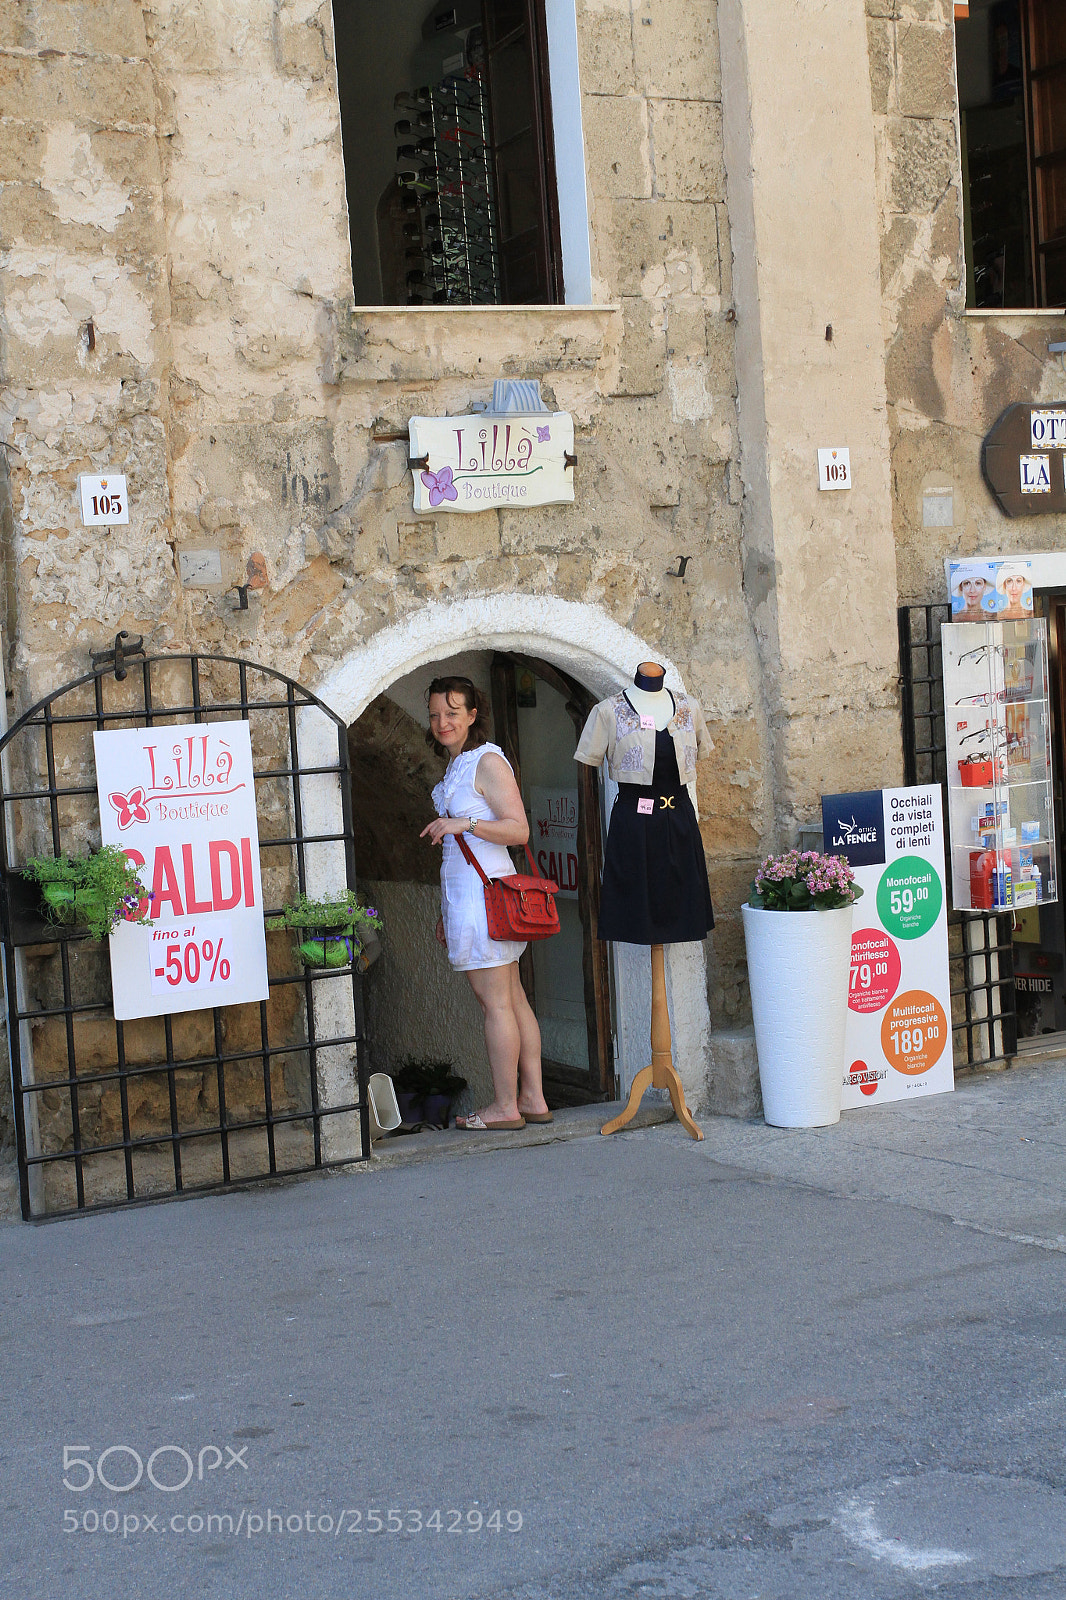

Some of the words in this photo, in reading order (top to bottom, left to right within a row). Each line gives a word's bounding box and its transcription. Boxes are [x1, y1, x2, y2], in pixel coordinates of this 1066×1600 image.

[452, 424, 533, 472] Lillà
[825, 463, 847, 482] 103
[1022, 463, 1050, 486] LA
[462, 482, 528, 502] Boutique
[91, 494, 123, 516] 105
[142, 734, 234, 791] Lillà
[890, 794, 933, 809] Occhiali
[154, 801, 230, 822] Boutique
[892, 811, 905, 823] da
[907, 809, 932, 821] vista
[858, 826, 877, 834] OTTICA
[890, 820, 935, 837] completi
[832, 836, 845, 847] LA
[846, 831, 877, 845] FENICE
[896, 837, 906, 849] di
[908, 835, 931, 848] lenti
[537, 850, 578, 891] SALD
[886, 873, 932, 888] Monofocali
[890, 887, 929, 915] 59,00
[152, 928, 179, 941] fino
[183, 926, 196, 938] al
[851, 937, 889, 951] onofocali
[154, 937, 231, 986] -50%
[850, 950, 889, 962] ntiriflesso
[849, 961, 888, 990] 79,00
[1028, 978, 1052, 992] HIDE
[892, 1002, 935, 1018] Multifocali
[890, 1014, 939, 1030] progressive
[890, 1026, 939, 1055] 189,00
